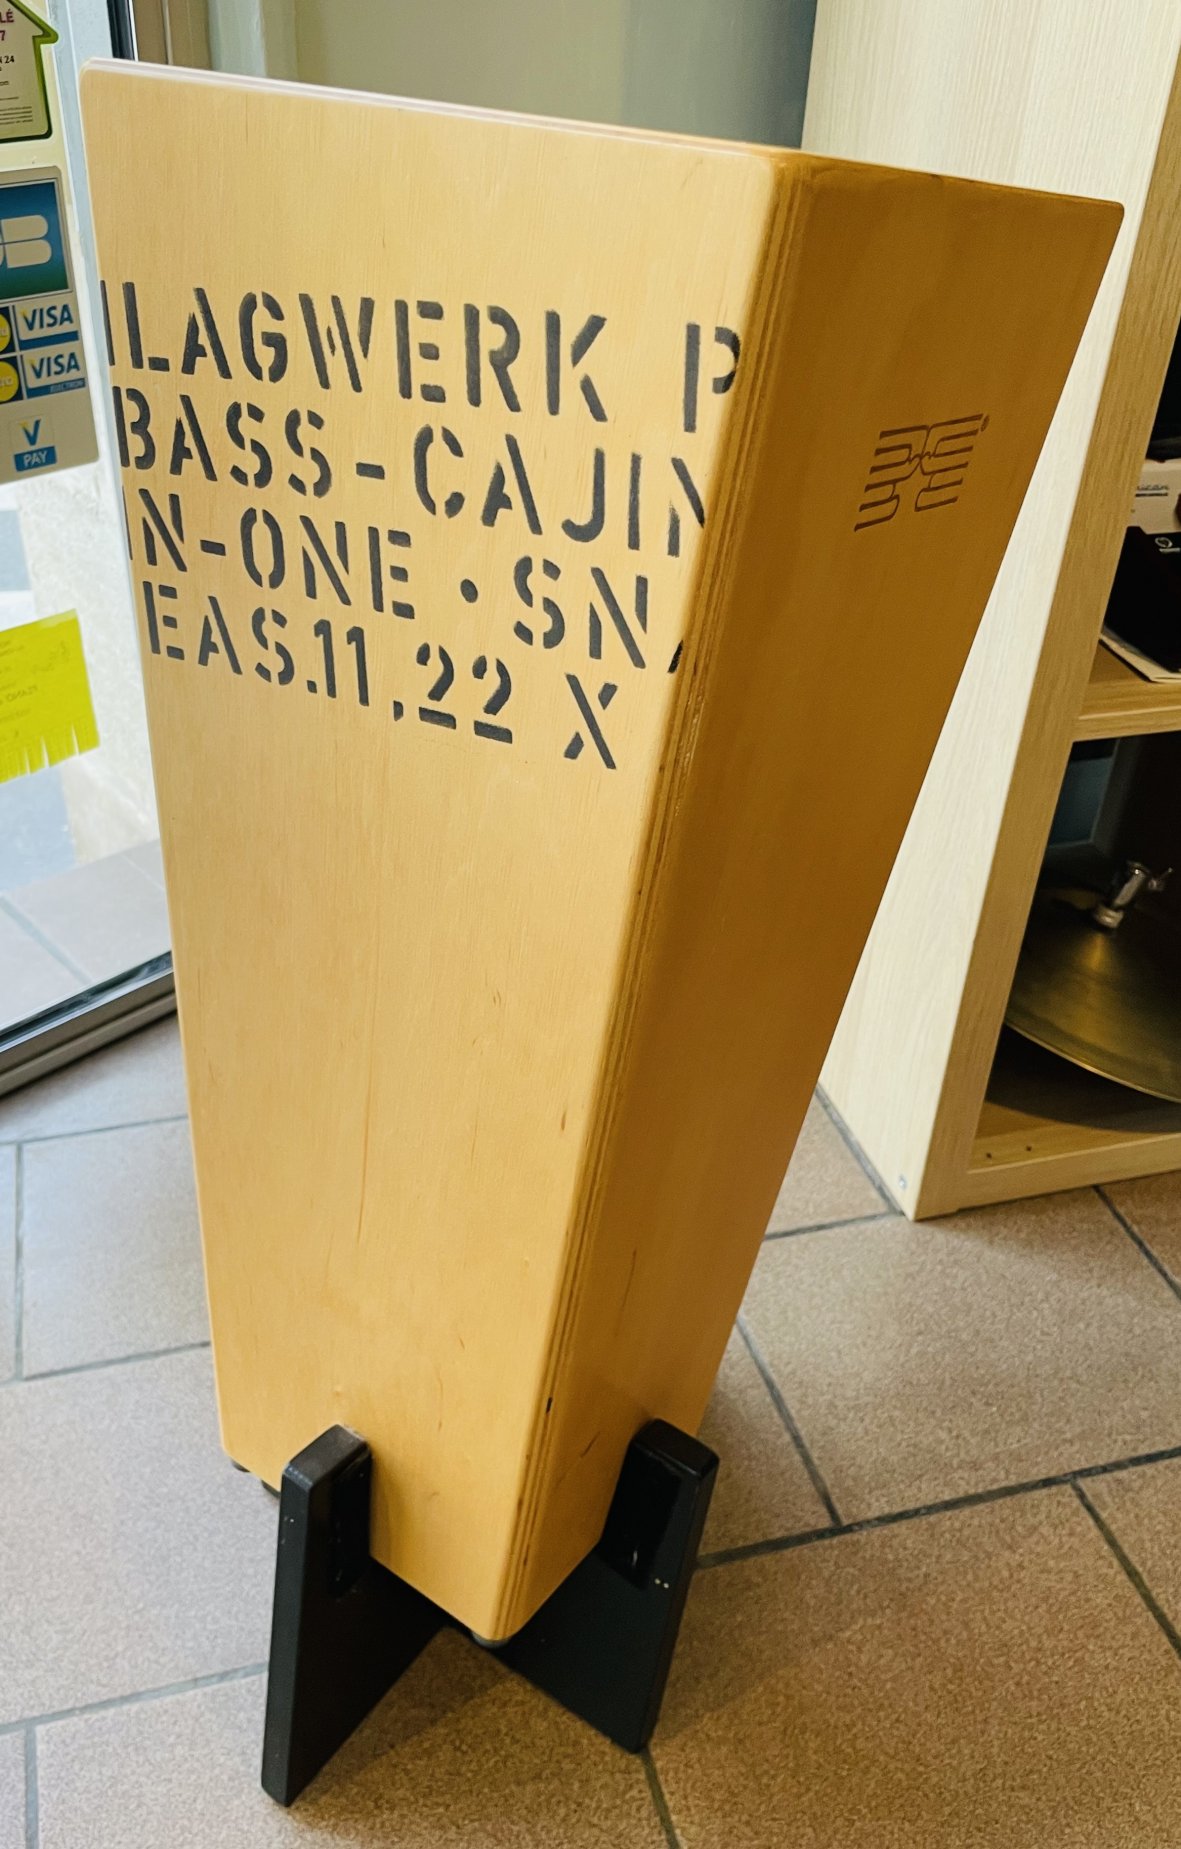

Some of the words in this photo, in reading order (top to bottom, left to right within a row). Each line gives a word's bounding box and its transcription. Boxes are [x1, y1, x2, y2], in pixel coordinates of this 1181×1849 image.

[21, 304, 73, 331] VISA
[27, 352, 80, 379] VISA
[99, 280, 607, 422] LAGWERK
[684, 322, 741, 433] P
[23, 450, 47, 468] PAY
[122, 486, 415, 619] N-ONE
[513, 556, 684, 674] SN
[564, 673, 617, 770] X
